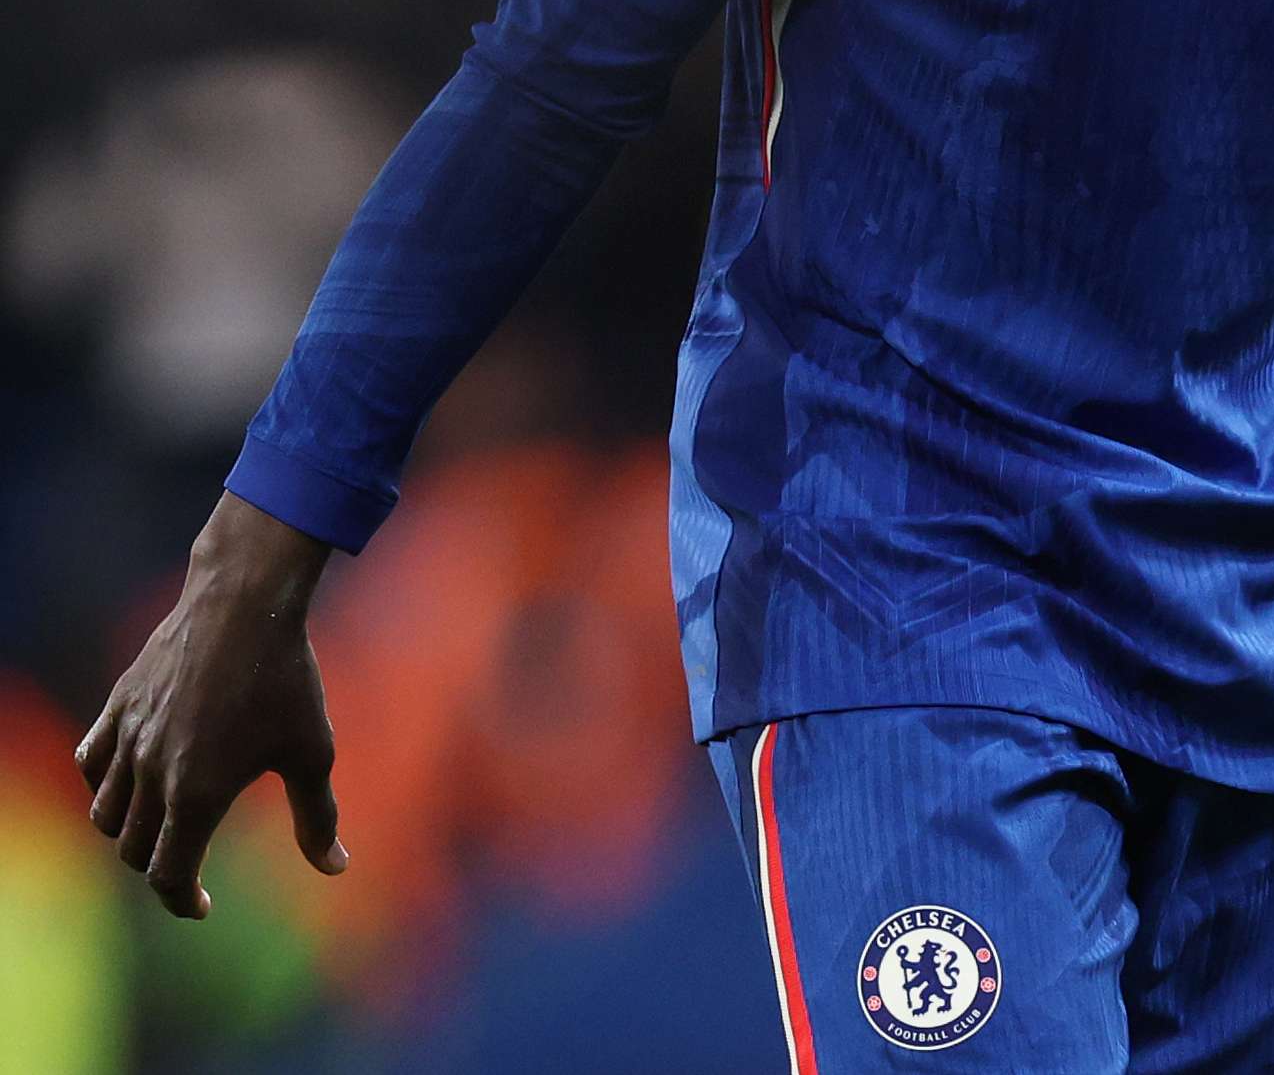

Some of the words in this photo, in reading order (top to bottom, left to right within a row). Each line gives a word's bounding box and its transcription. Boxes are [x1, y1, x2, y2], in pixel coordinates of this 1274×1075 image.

[876, 911, 965, 948] CHELSEA
[888, 1023, 948, 1042] FOOTBALL
[953, 1008, 981, 1034] CLUB
